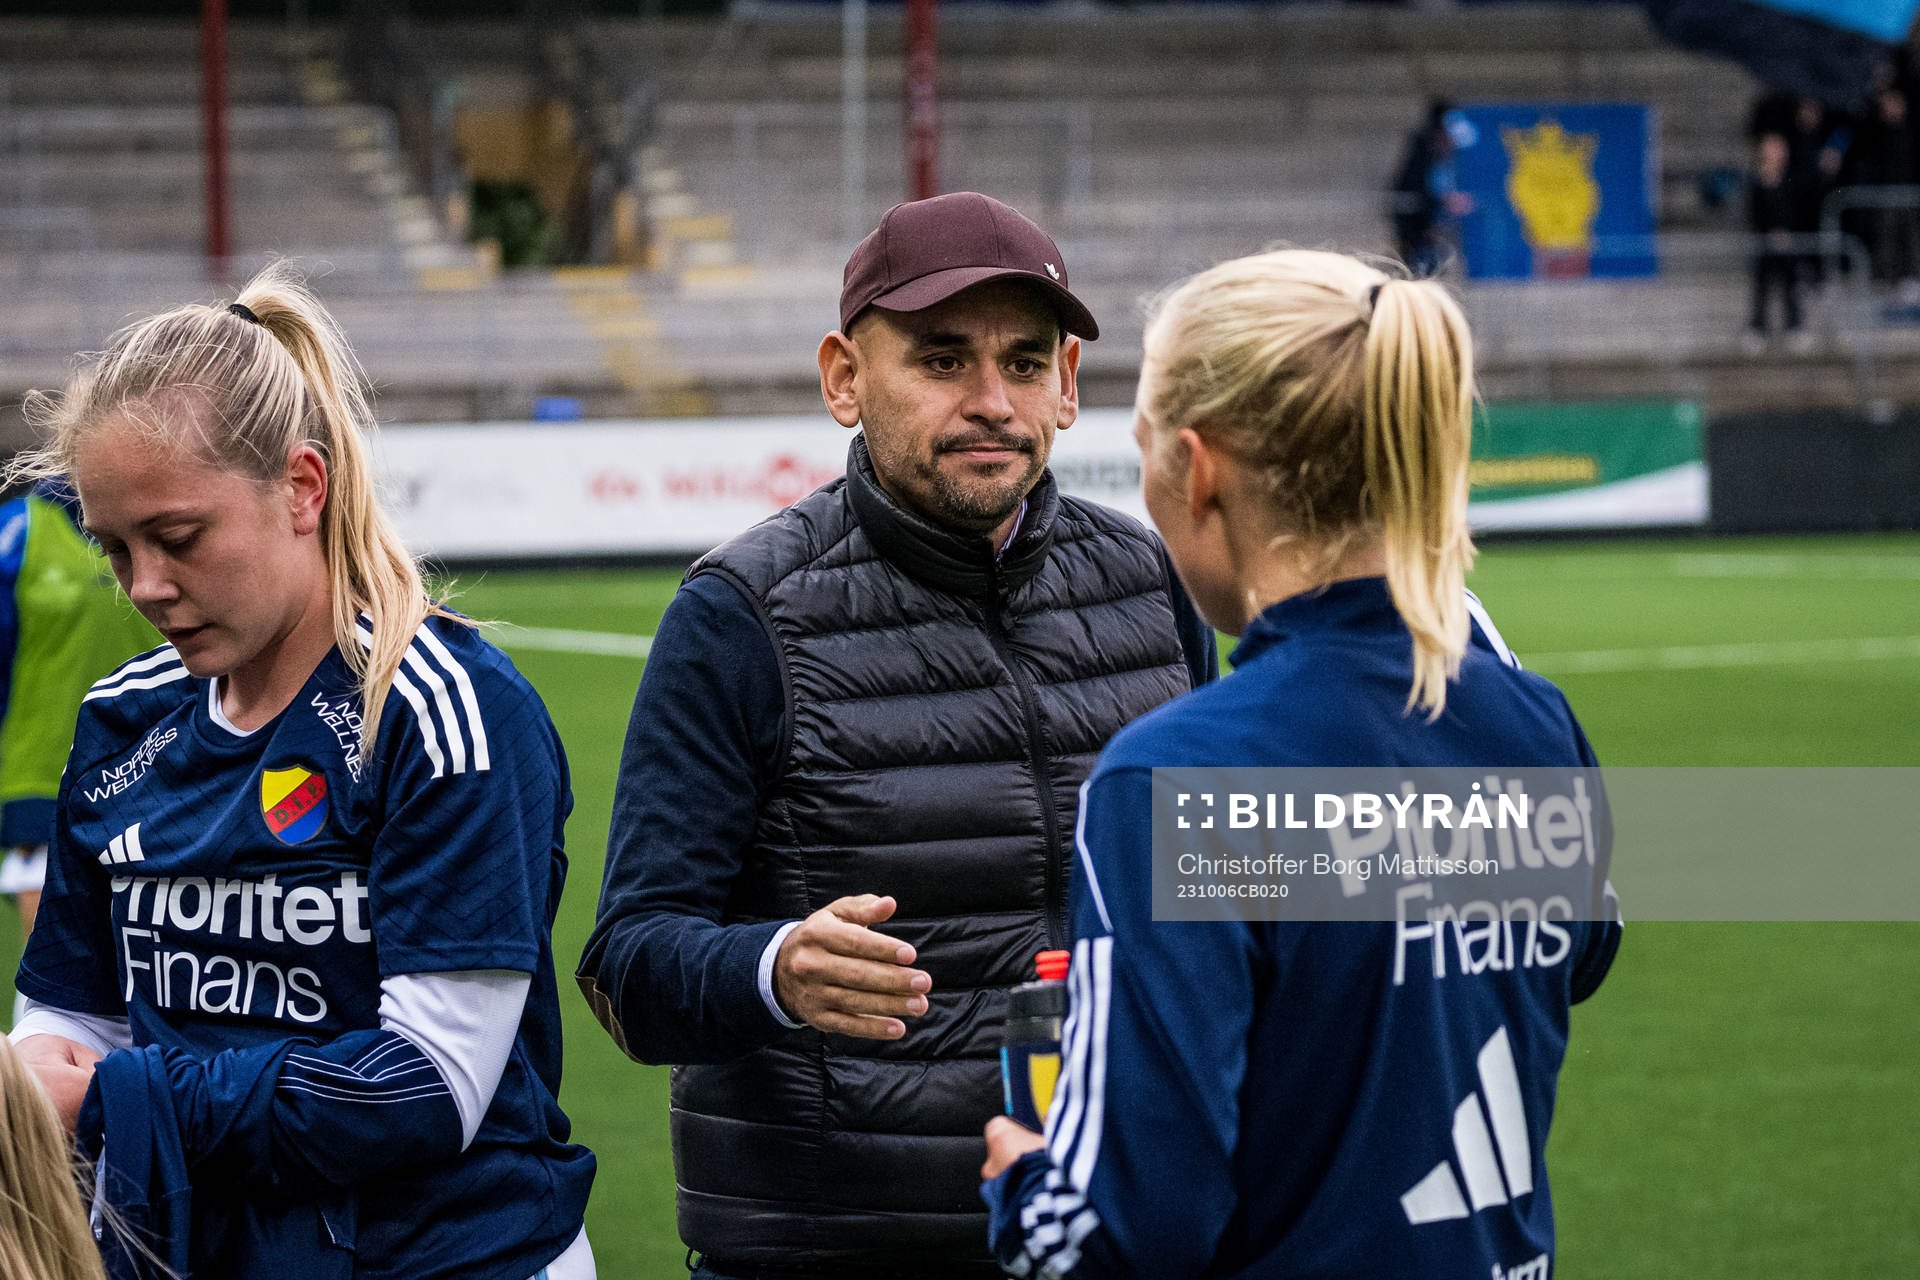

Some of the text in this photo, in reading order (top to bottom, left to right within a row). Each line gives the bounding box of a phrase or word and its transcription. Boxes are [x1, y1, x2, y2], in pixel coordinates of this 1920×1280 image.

[84, 728, 178, 803] WELLNESS
[102, 727, 160, 783] NORDIC
[122, 926, 328, 1023] Finans
